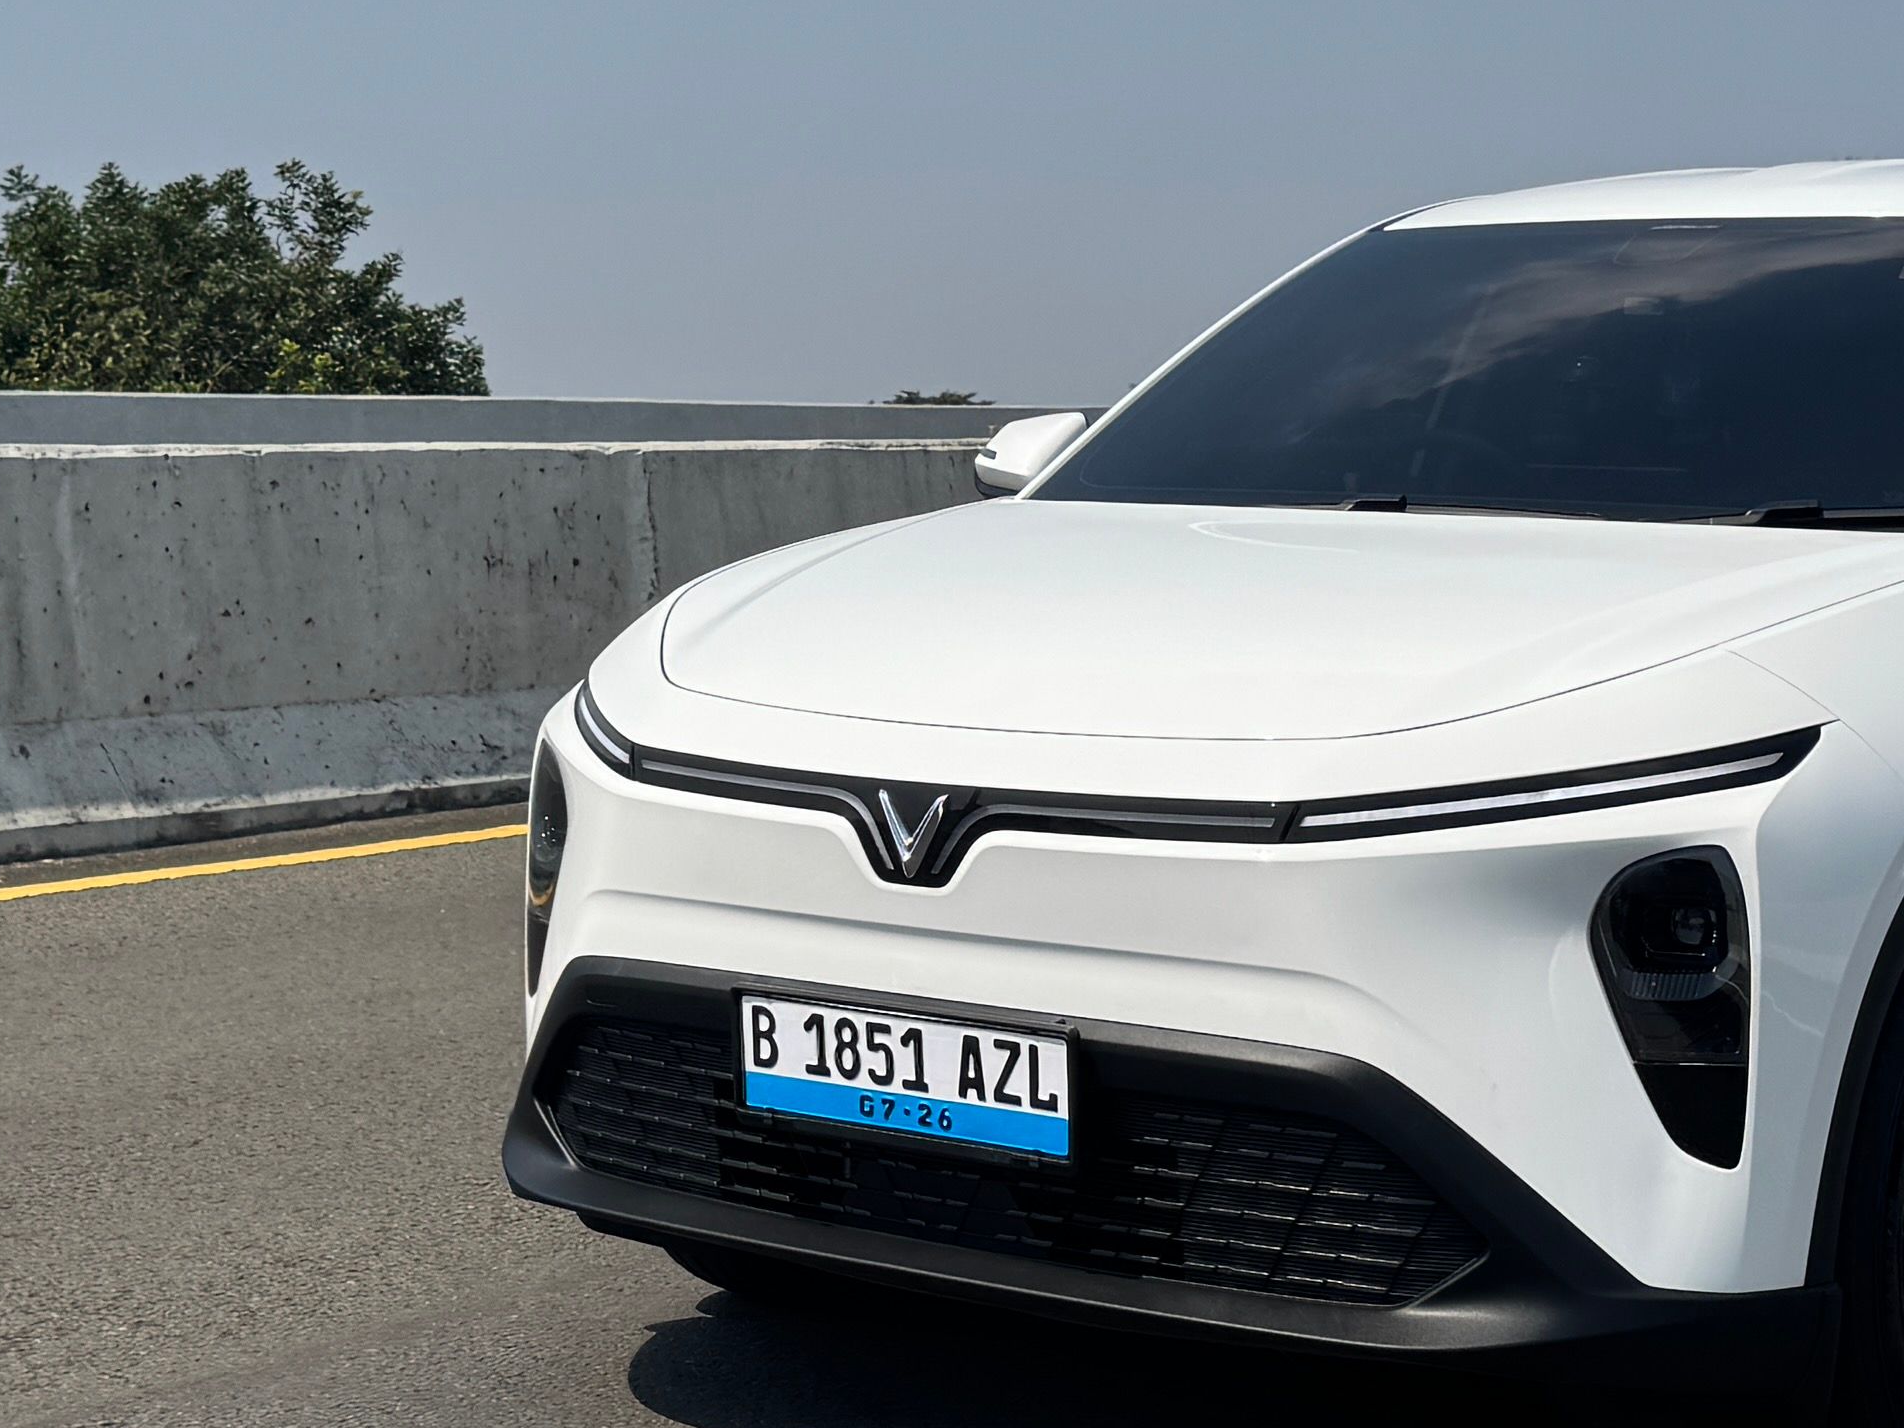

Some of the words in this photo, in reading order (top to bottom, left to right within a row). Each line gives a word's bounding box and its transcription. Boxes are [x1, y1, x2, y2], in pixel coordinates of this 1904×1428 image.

[750, 1004, 779, 1069] B
[802, 1012, 930, 1094] 1851
[957, 1034, 1059, 1113] AZL
